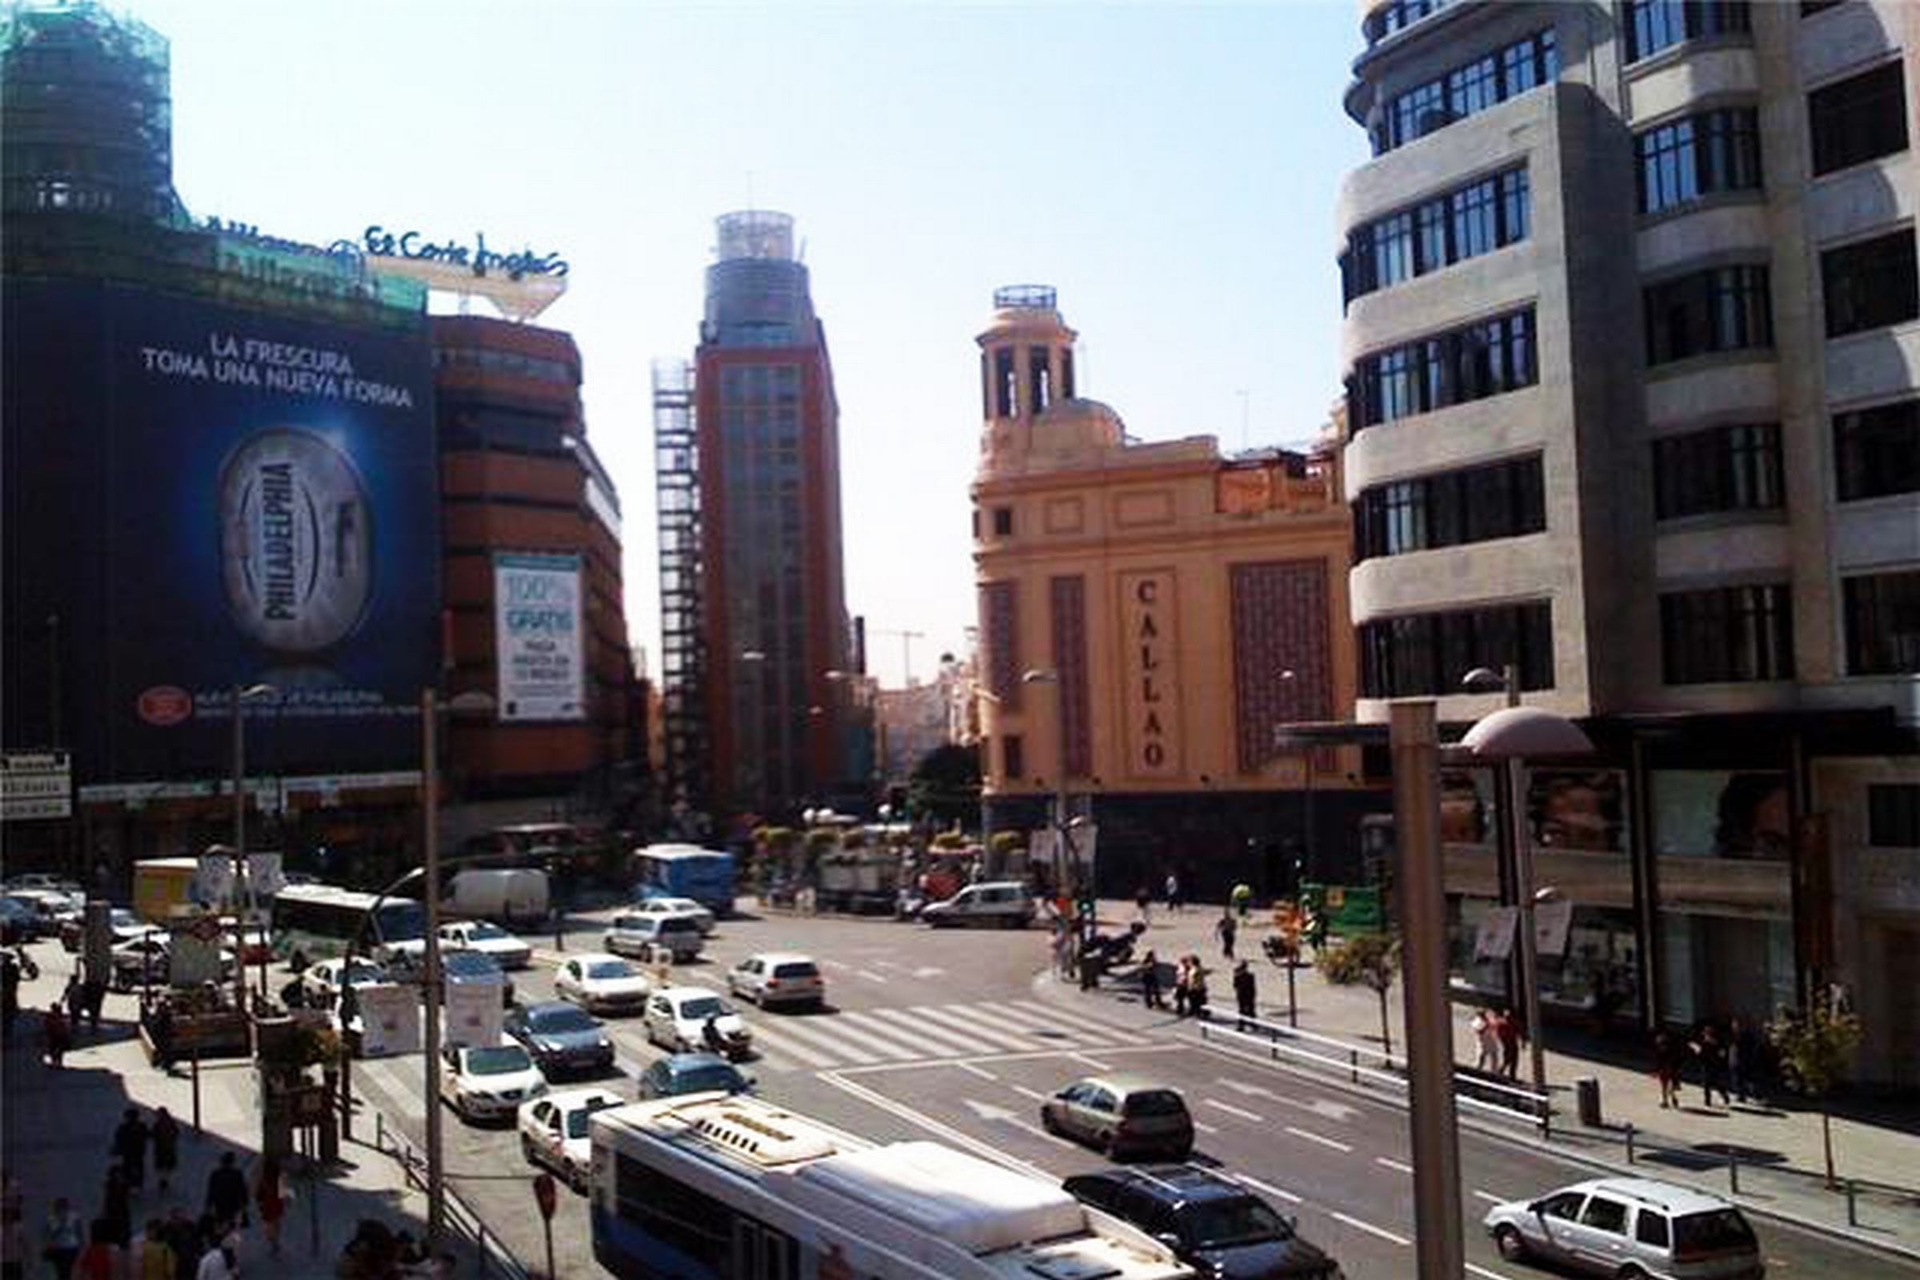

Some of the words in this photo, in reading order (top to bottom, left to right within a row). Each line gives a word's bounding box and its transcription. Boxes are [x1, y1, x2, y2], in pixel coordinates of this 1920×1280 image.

[401, 231, 469, 266] Corte
[141, 347, 208, 381] TOMA
[214, 359, 261, 386] UNA
[266, 366, 339, 398] NUEVA
[344, 380, 414, 407] FORMA
[210, 332, 239, 359] LA
[244, 339, 354, 376] FRESCURA
[261, 463, 296, 621] PHILADELPHIA
[1137, 578, 1164, 767] CALLAO
